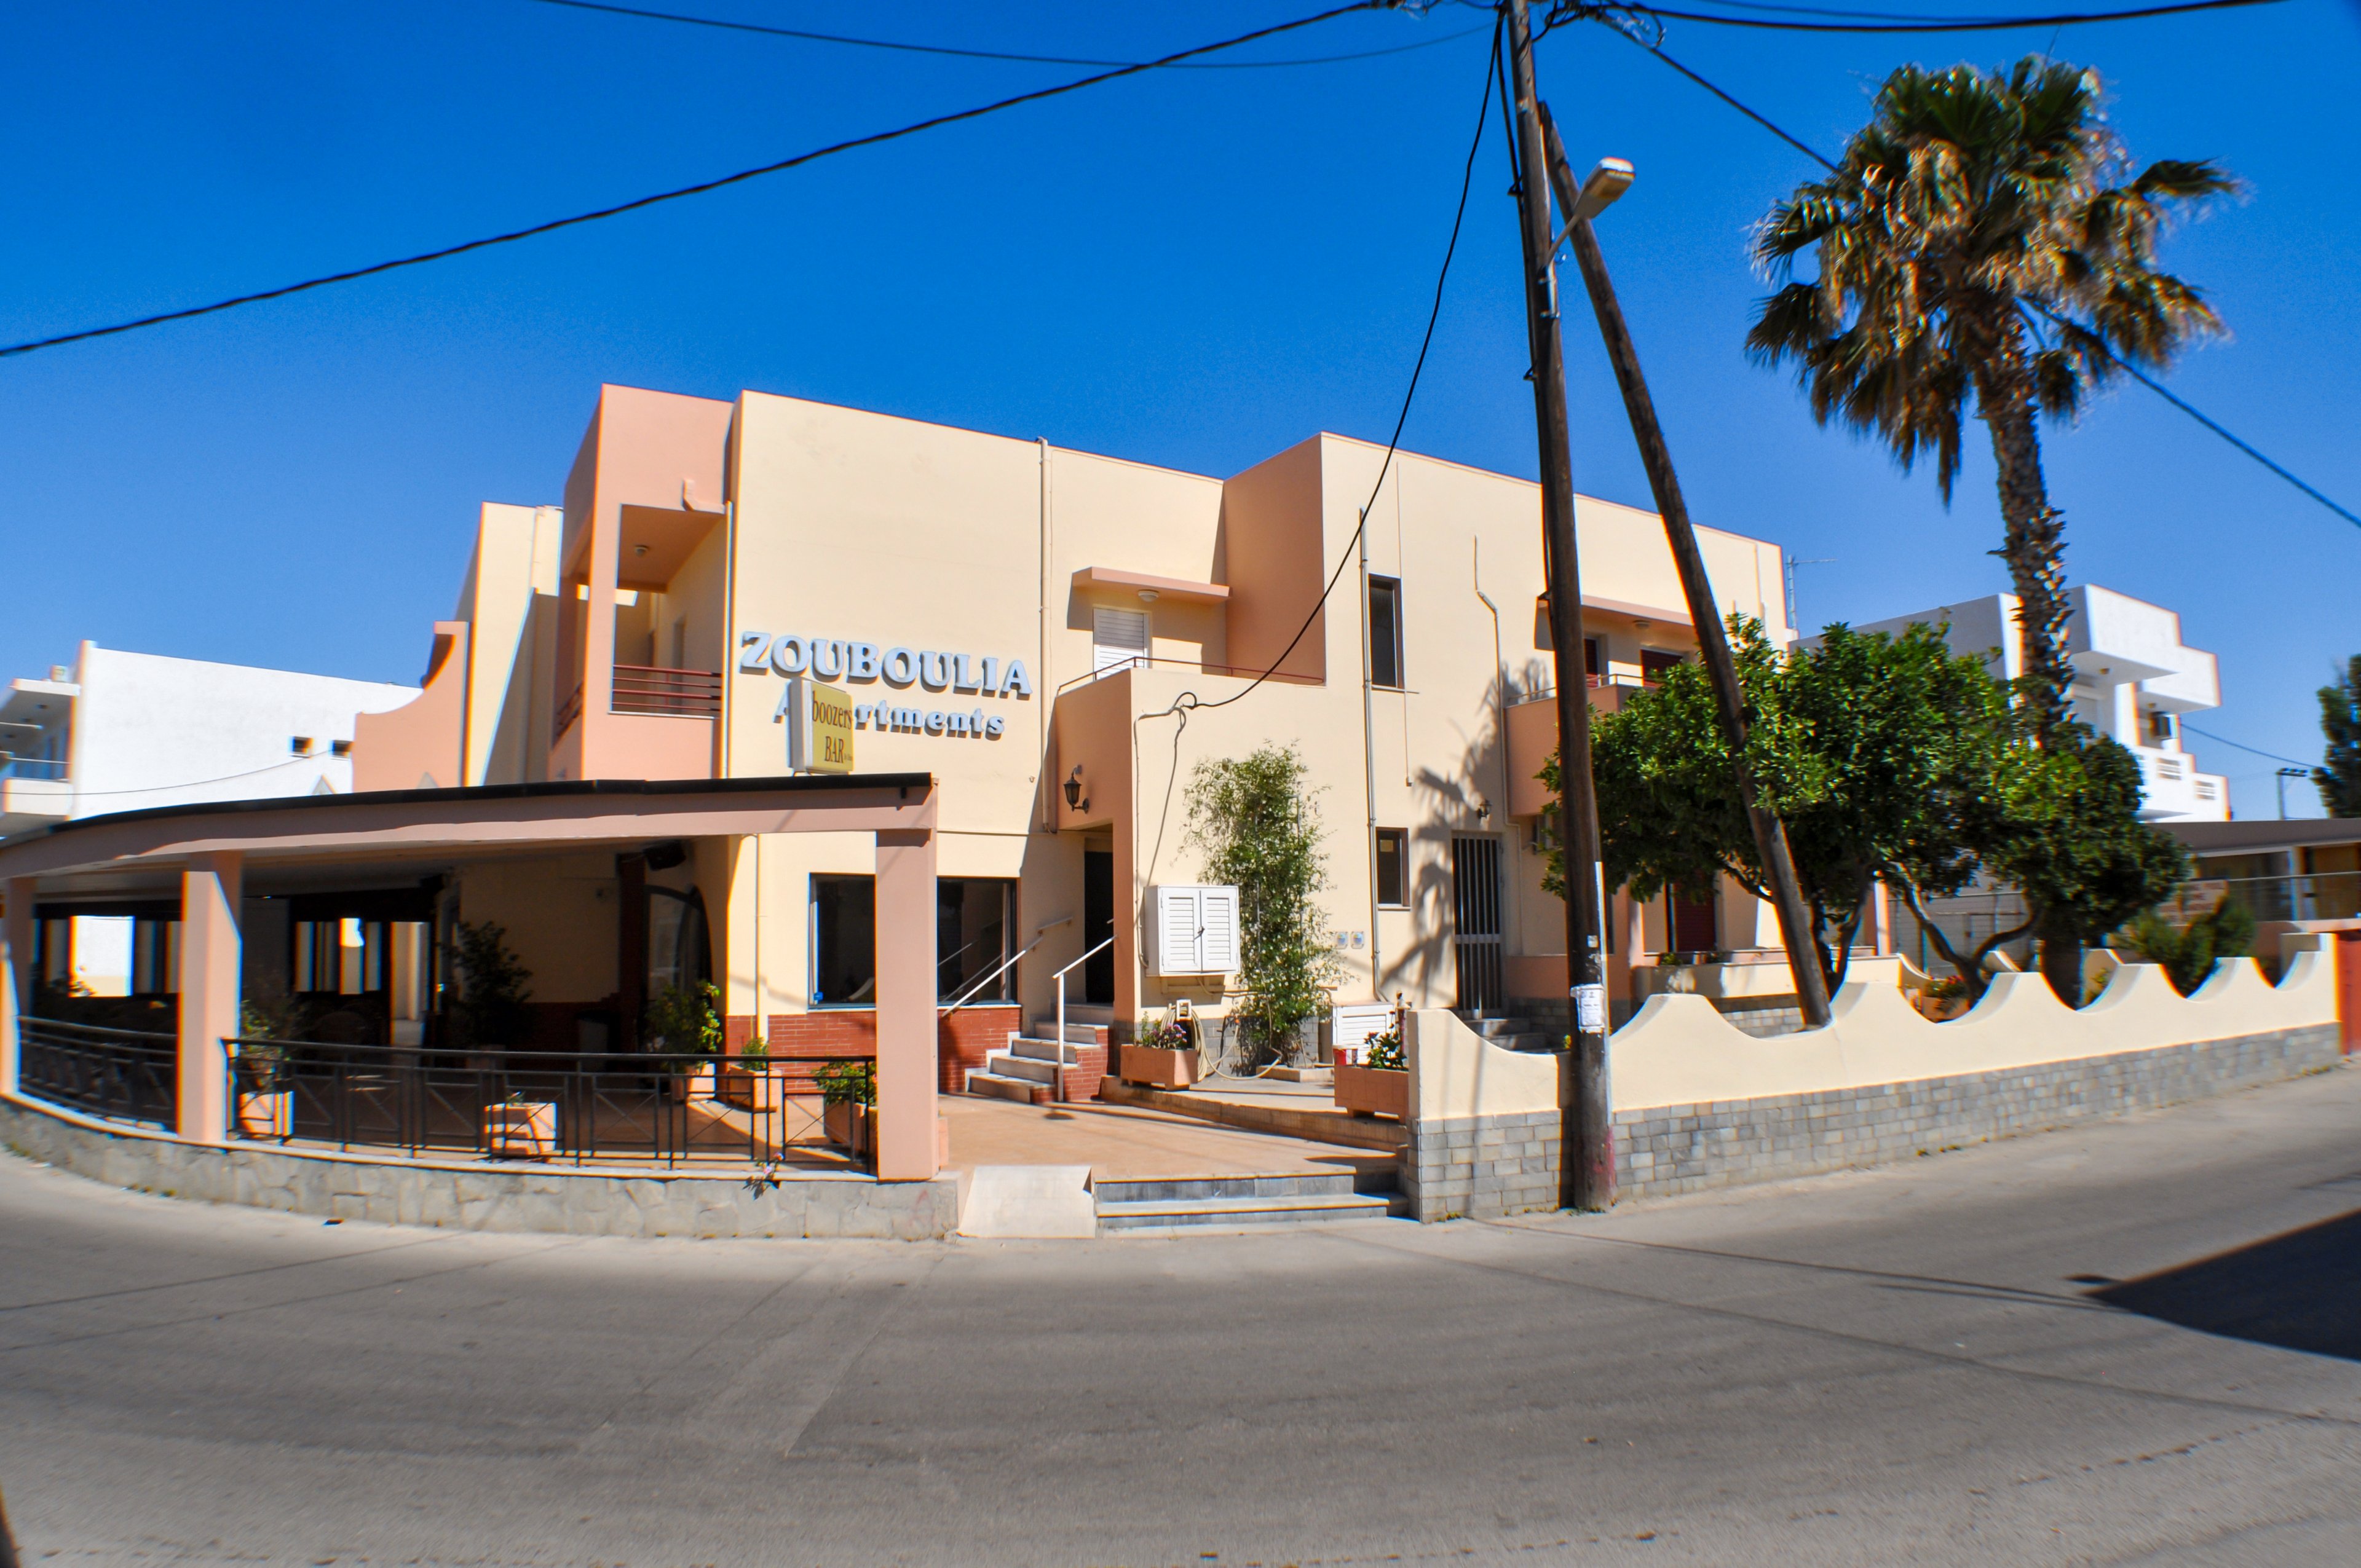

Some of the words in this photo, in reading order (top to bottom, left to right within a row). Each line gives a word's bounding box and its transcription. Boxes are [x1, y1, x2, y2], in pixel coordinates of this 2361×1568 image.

[740, 631, 1033, 695] ZOUBOULIA
[812, 690, 852, 730] boozers
[825, 736, 844, 763] BAR
